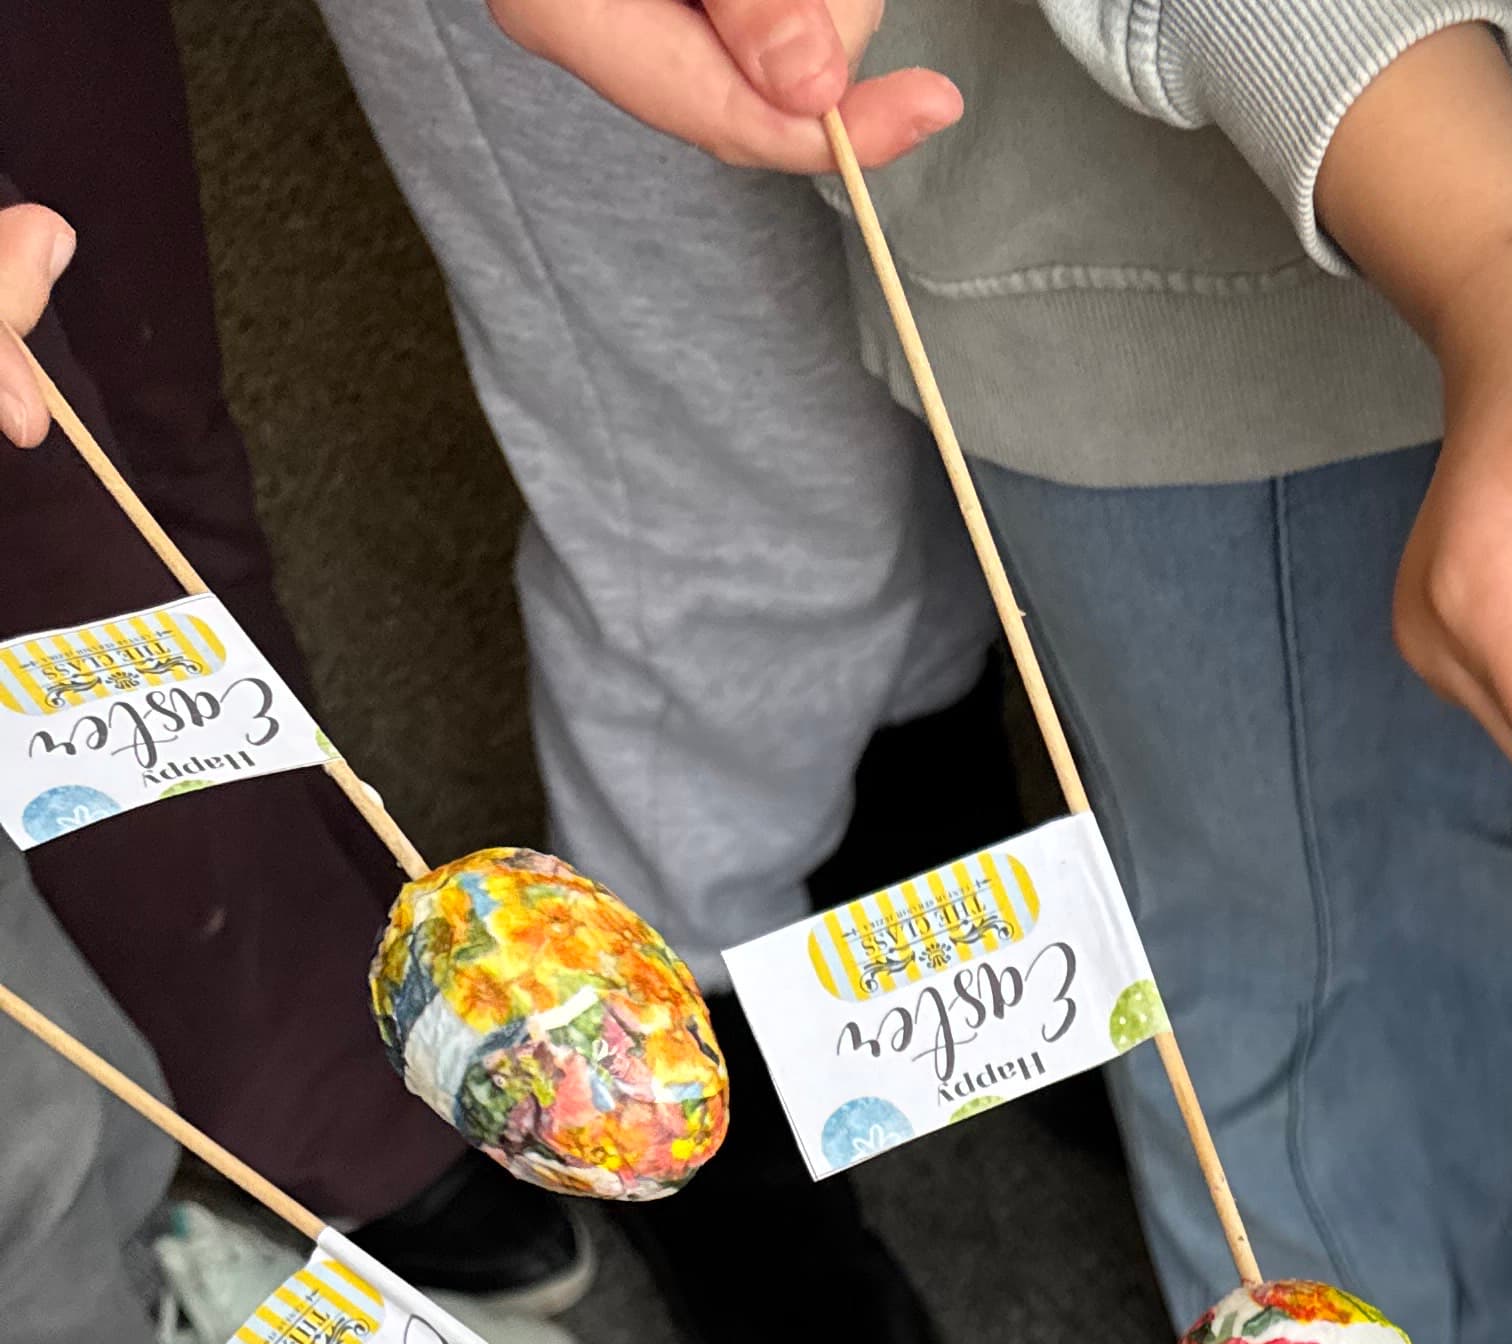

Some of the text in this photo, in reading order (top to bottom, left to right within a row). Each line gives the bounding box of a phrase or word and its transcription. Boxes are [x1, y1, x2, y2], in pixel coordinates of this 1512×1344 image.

[43, 643, 170, 676] THE CLASS
[28, 677, 280, 770] Easter
[143, 750, 256, 788] Happy
[862, 896, 985, 950] THE CLASS
[836, 941, 1078, 1082] Easter
[937, 1052, 1047, 1106] Happy
